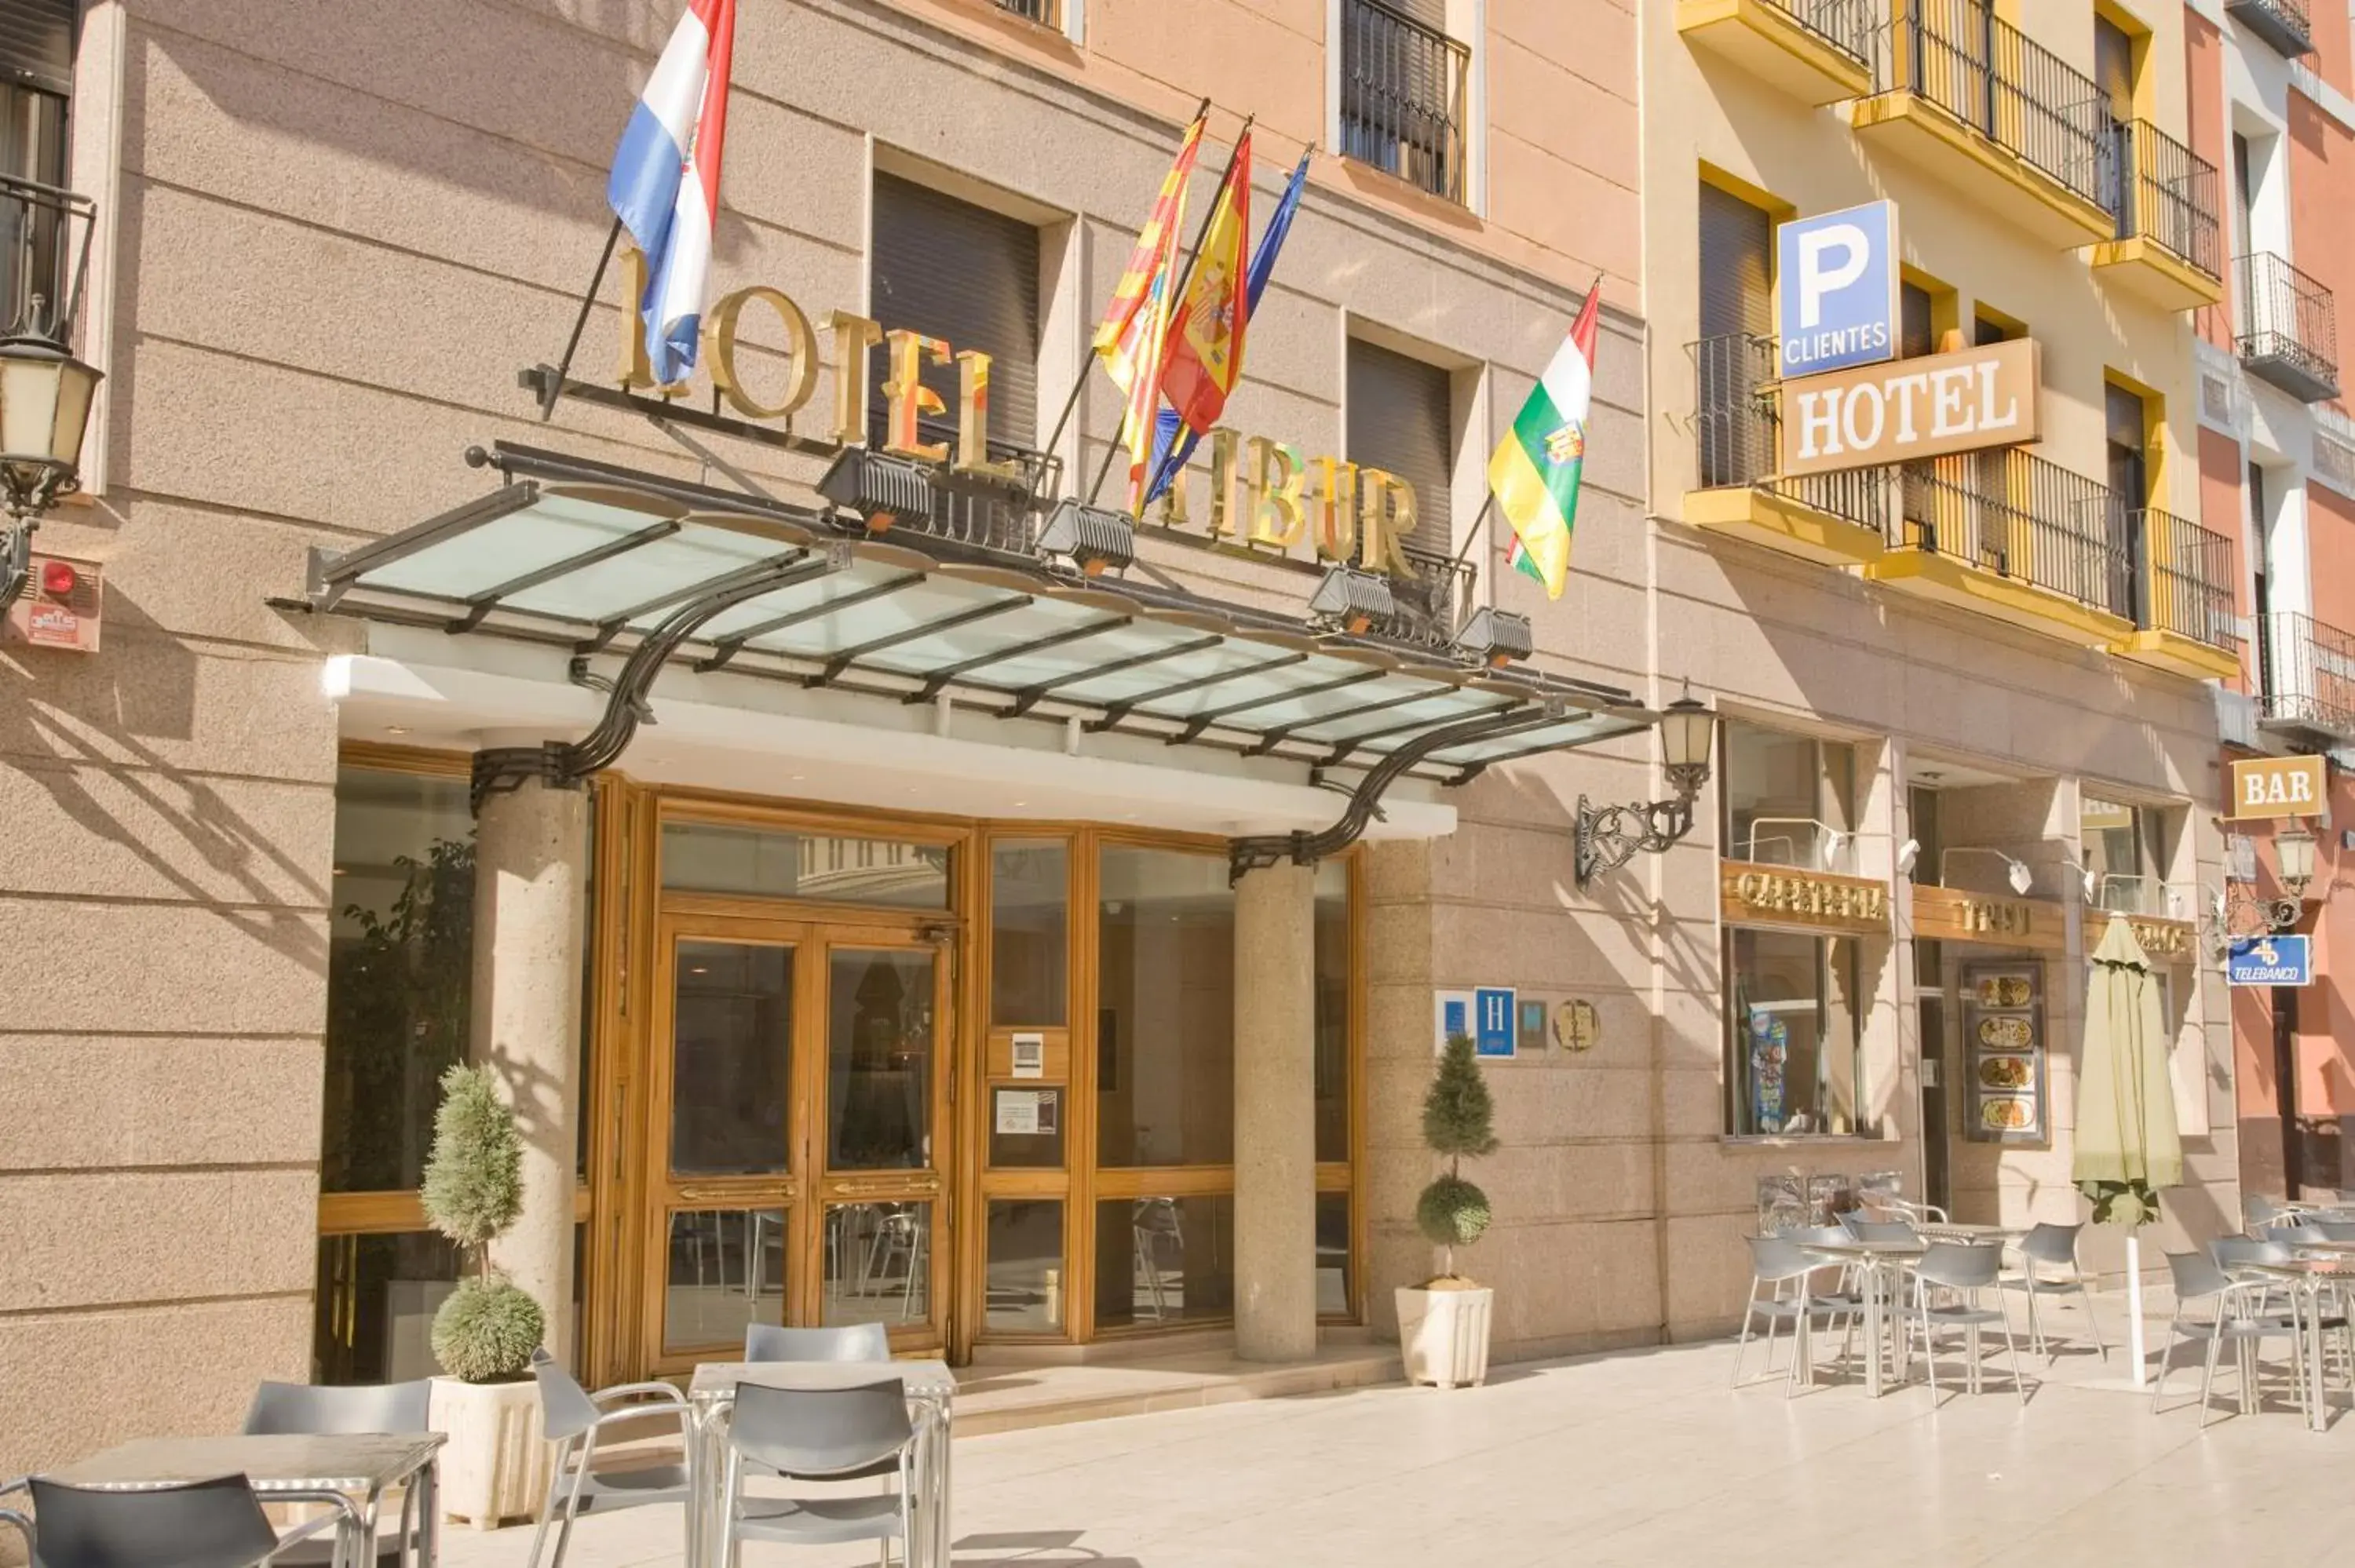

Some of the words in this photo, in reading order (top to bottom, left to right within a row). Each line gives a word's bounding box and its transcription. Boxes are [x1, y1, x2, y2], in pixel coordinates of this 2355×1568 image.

[1797, 223, 1871, 330] P
[1784, 322, 1888, 365] CLIENTES
[1797, 360, 2018, 460] HOTEL
[2244, 771, 2313, 804] BAR
[2234, 966, 2299, 980] TELEBANCO
[1486, 995, 1505, 1031] H
